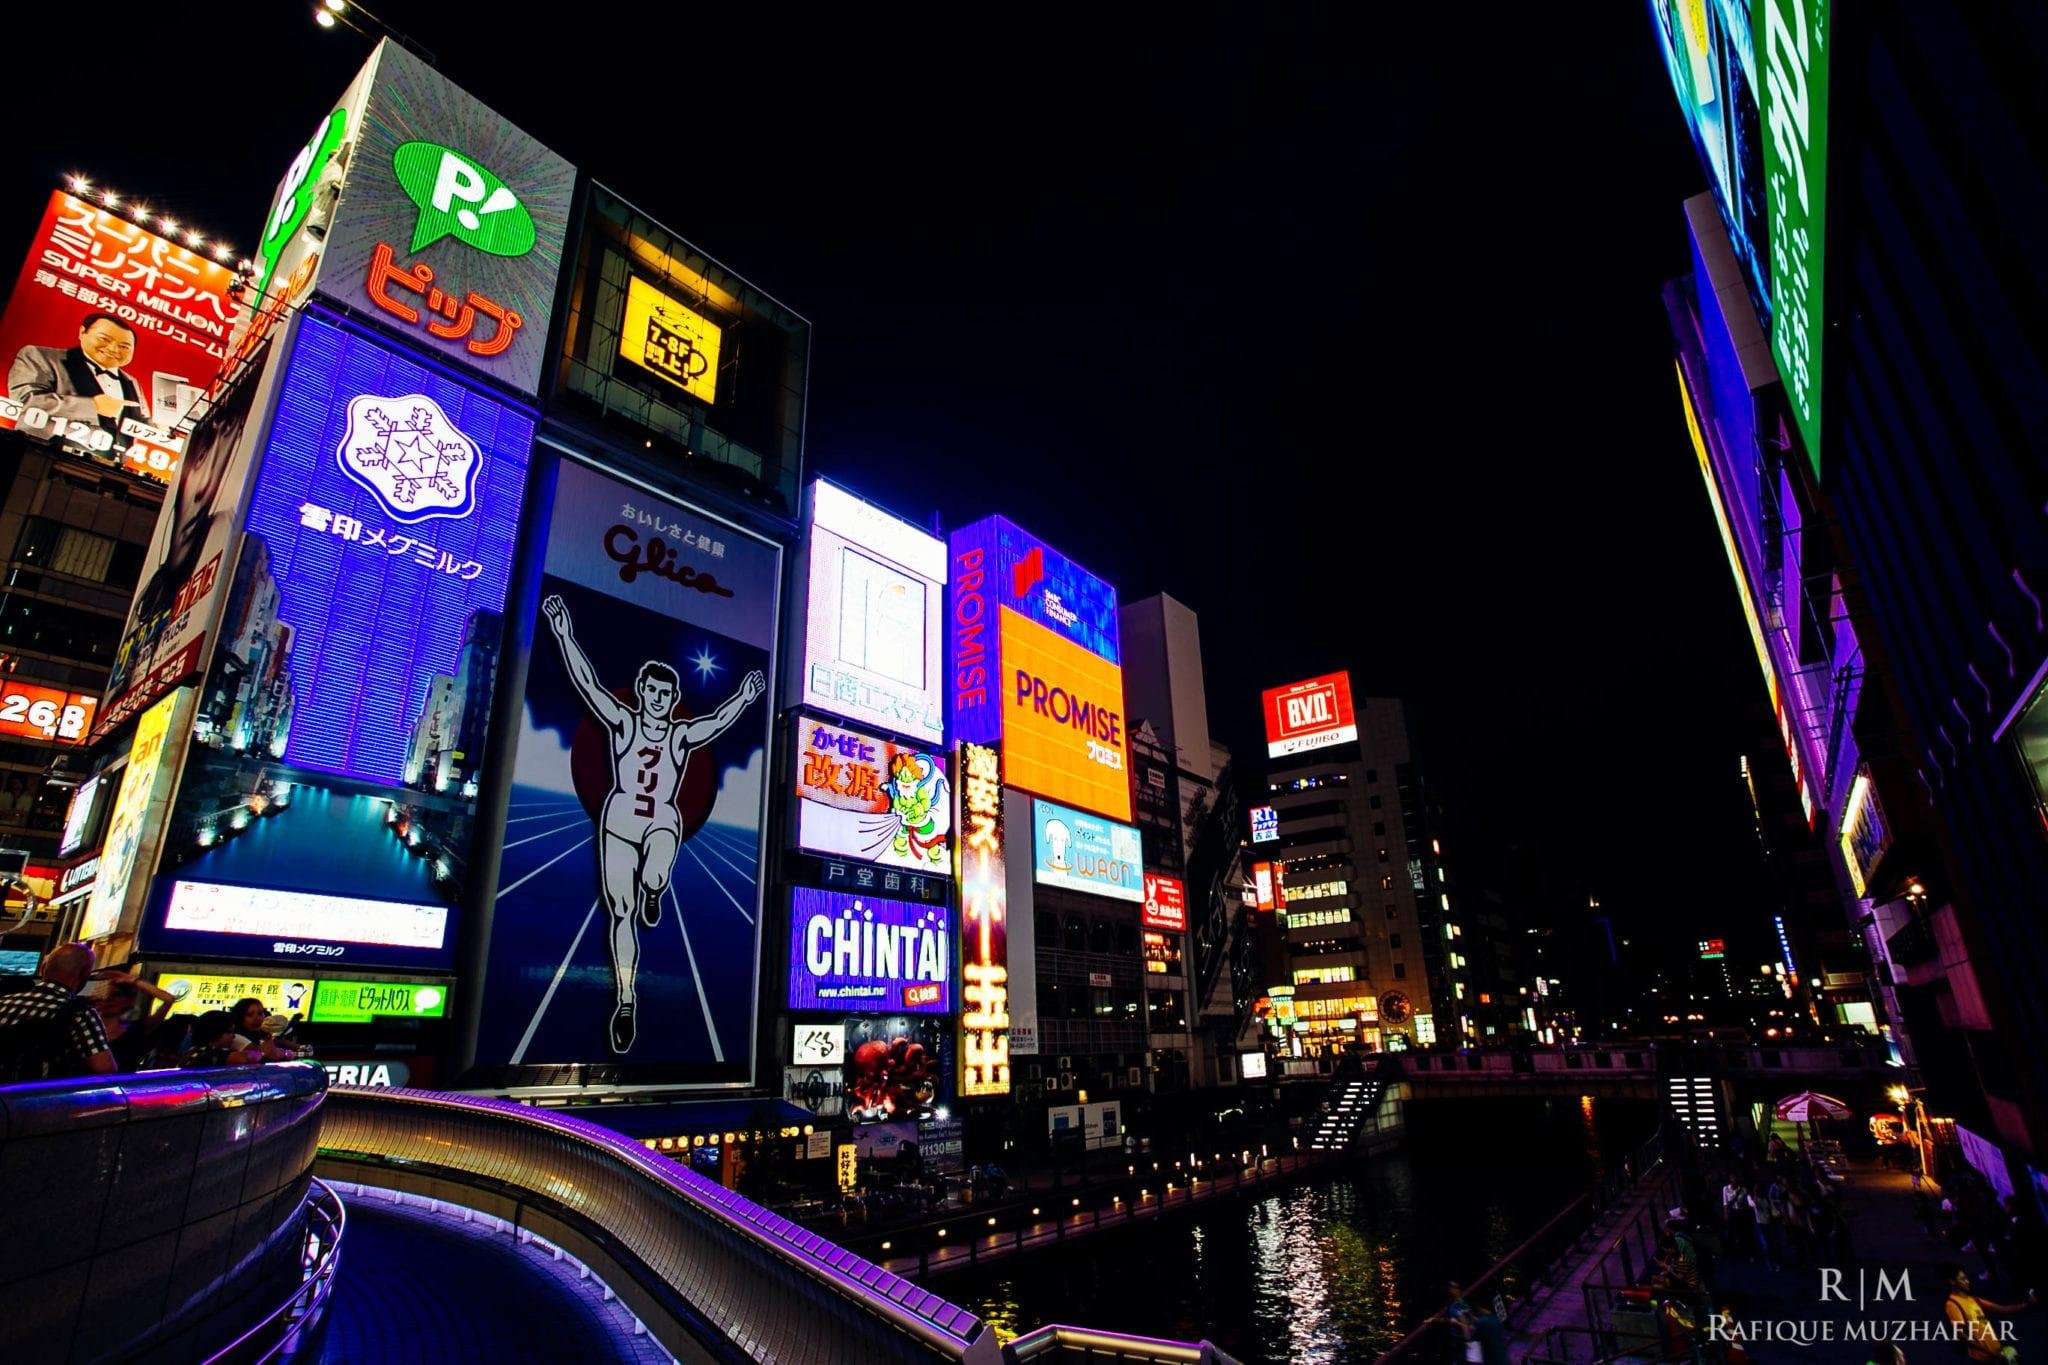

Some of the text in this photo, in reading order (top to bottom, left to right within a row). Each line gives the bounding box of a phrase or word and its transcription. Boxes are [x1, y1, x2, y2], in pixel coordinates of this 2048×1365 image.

[56, 196, 200, 275] スーパー
[41, 249, 223, 337] SUPER MILLION
[366, 241, 522, 356] ピップ
[650, 324, 690, 357] 7-8F
[23, 406, 178, 473] 0120-49
[299, 502, 483, 581] 雪印メグミルク
[604, 524, 736, 598] Glico
[620, 503, 726, 559] おいしさと健康
[956, 547, 987, 712] PROMISE
[1016, 669, 1121, 747] PROMISE
[1286, 692, 1333, 728] B.V.D.
[1298, 732, 1340, 747] FUJIBO
[802, 751, 881, 803] 改源
[811, 726, 876, 763] かぜに
[633, 745, 664, 819] グリコ
[828, 864, 926, 893] 戸堂歯科
[272, 941, 346, 957] 雪印メグミルク
